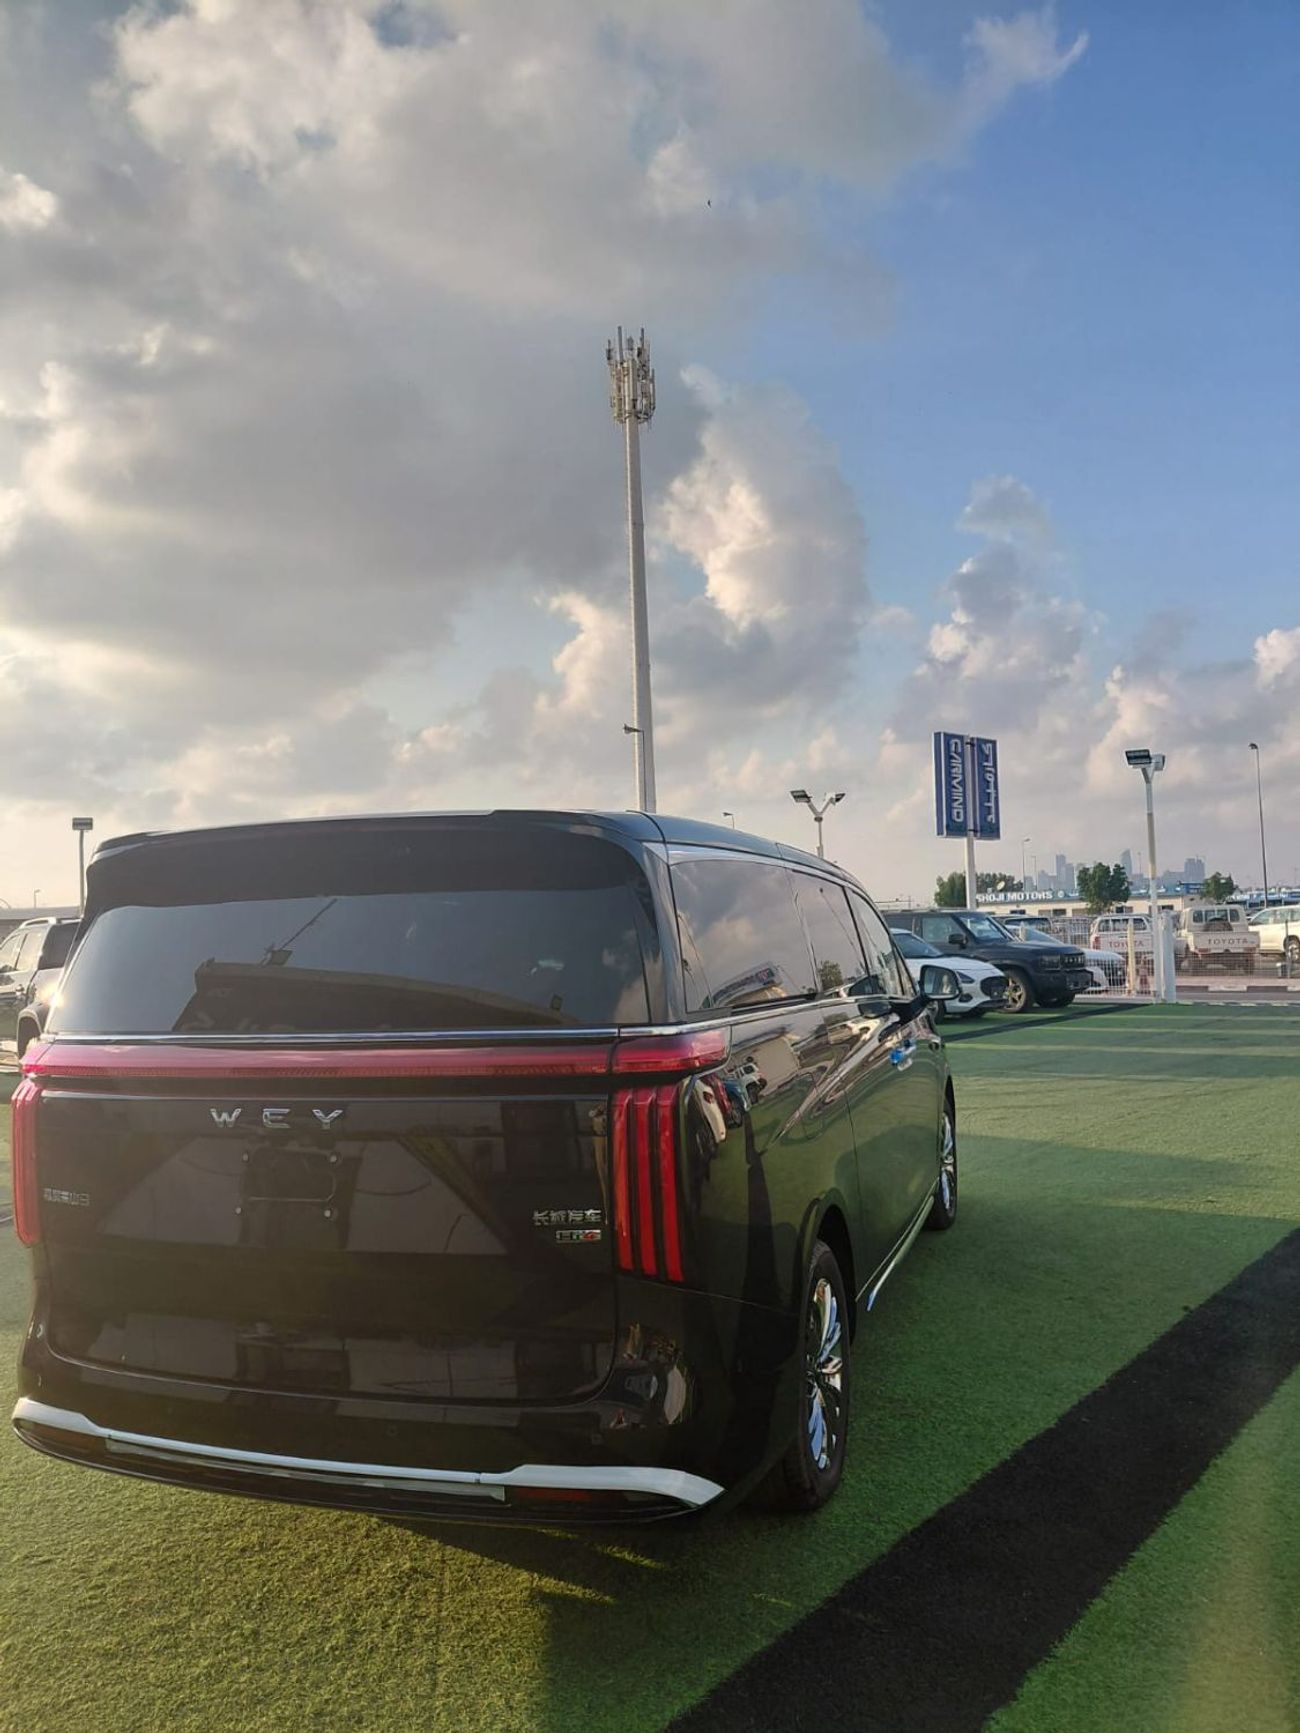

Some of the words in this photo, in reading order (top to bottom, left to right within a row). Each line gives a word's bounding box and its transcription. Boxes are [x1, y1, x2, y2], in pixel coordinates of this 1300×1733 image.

[949, 739, 964, 822] CARMIND
[1007, 890, 1053, 902] MOTORS
[209, 1107, 344, 1130] WEY
